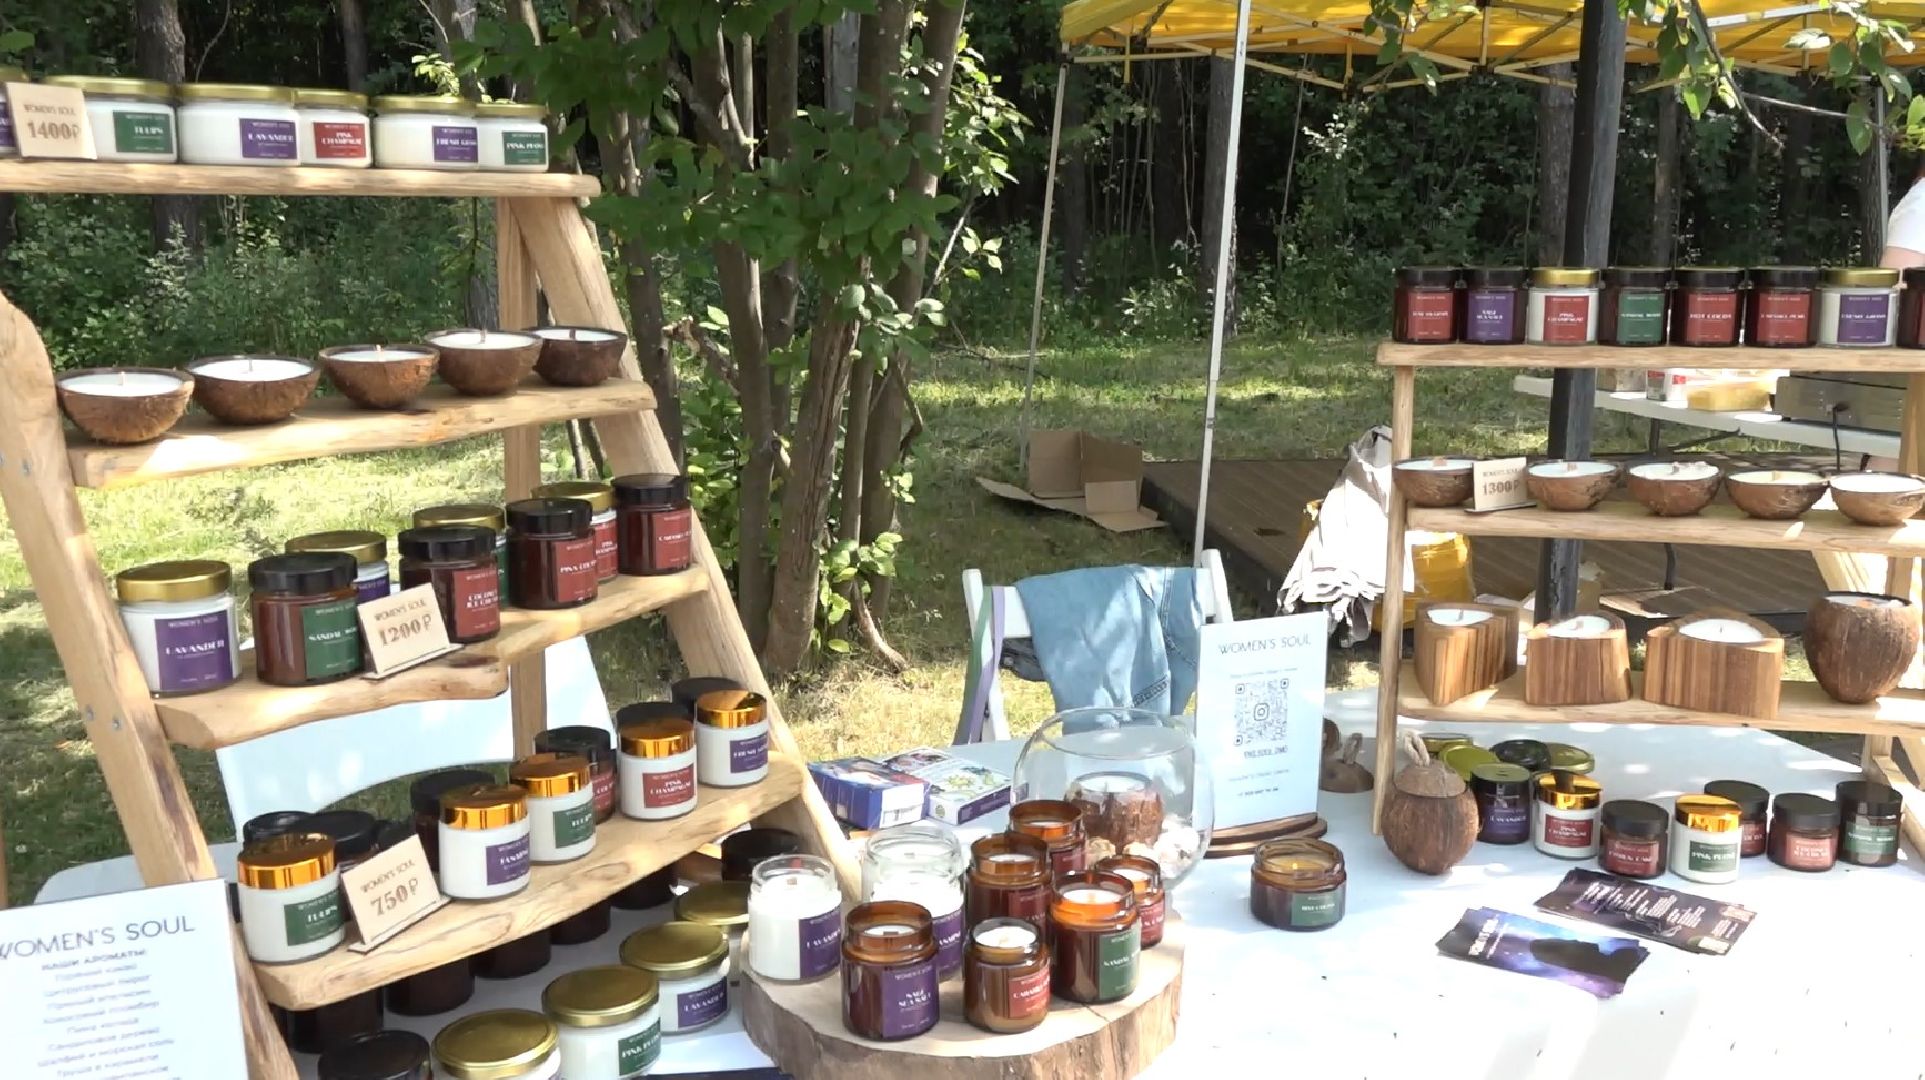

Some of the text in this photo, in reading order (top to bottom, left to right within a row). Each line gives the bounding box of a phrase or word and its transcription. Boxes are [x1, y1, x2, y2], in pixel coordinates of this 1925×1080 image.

[165, 640, 225, 655] LAVANDER
[1219, 632, 1311, 655] WOMEN'S SOUL
[126, 915, 196, 941] SOUL
